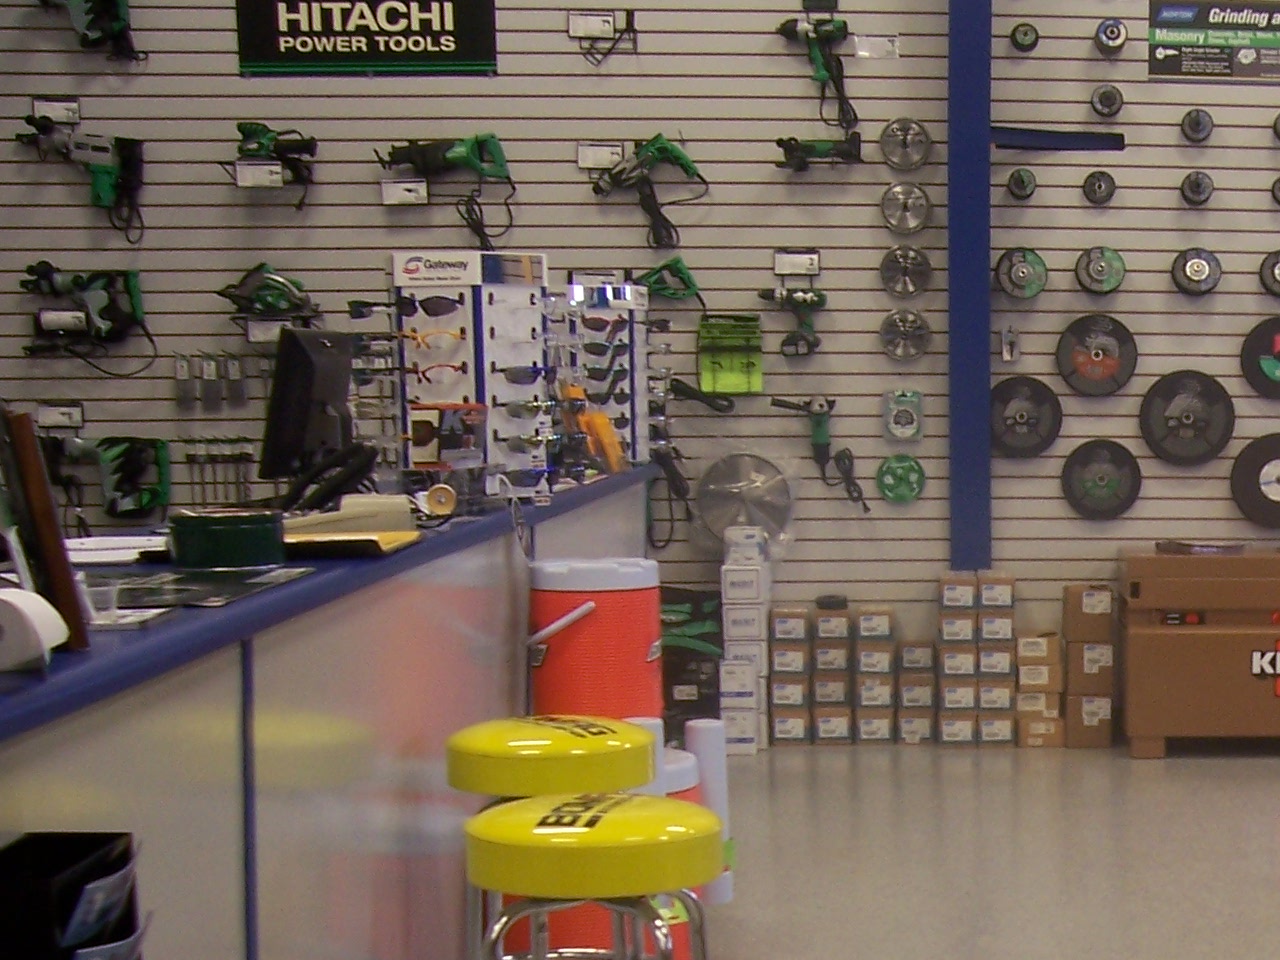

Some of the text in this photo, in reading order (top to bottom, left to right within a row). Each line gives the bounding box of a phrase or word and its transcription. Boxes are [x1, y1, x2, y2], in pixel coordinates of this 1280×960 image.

[277, 1, 455, 32] HITACHI
[1209, 8, 1269, 27] Grinding
[279, 35, 456, 53] POWER TOOLS
[1154, 28, 1205, 44] Masonry
[423, 259, 469, 271] Gateway
